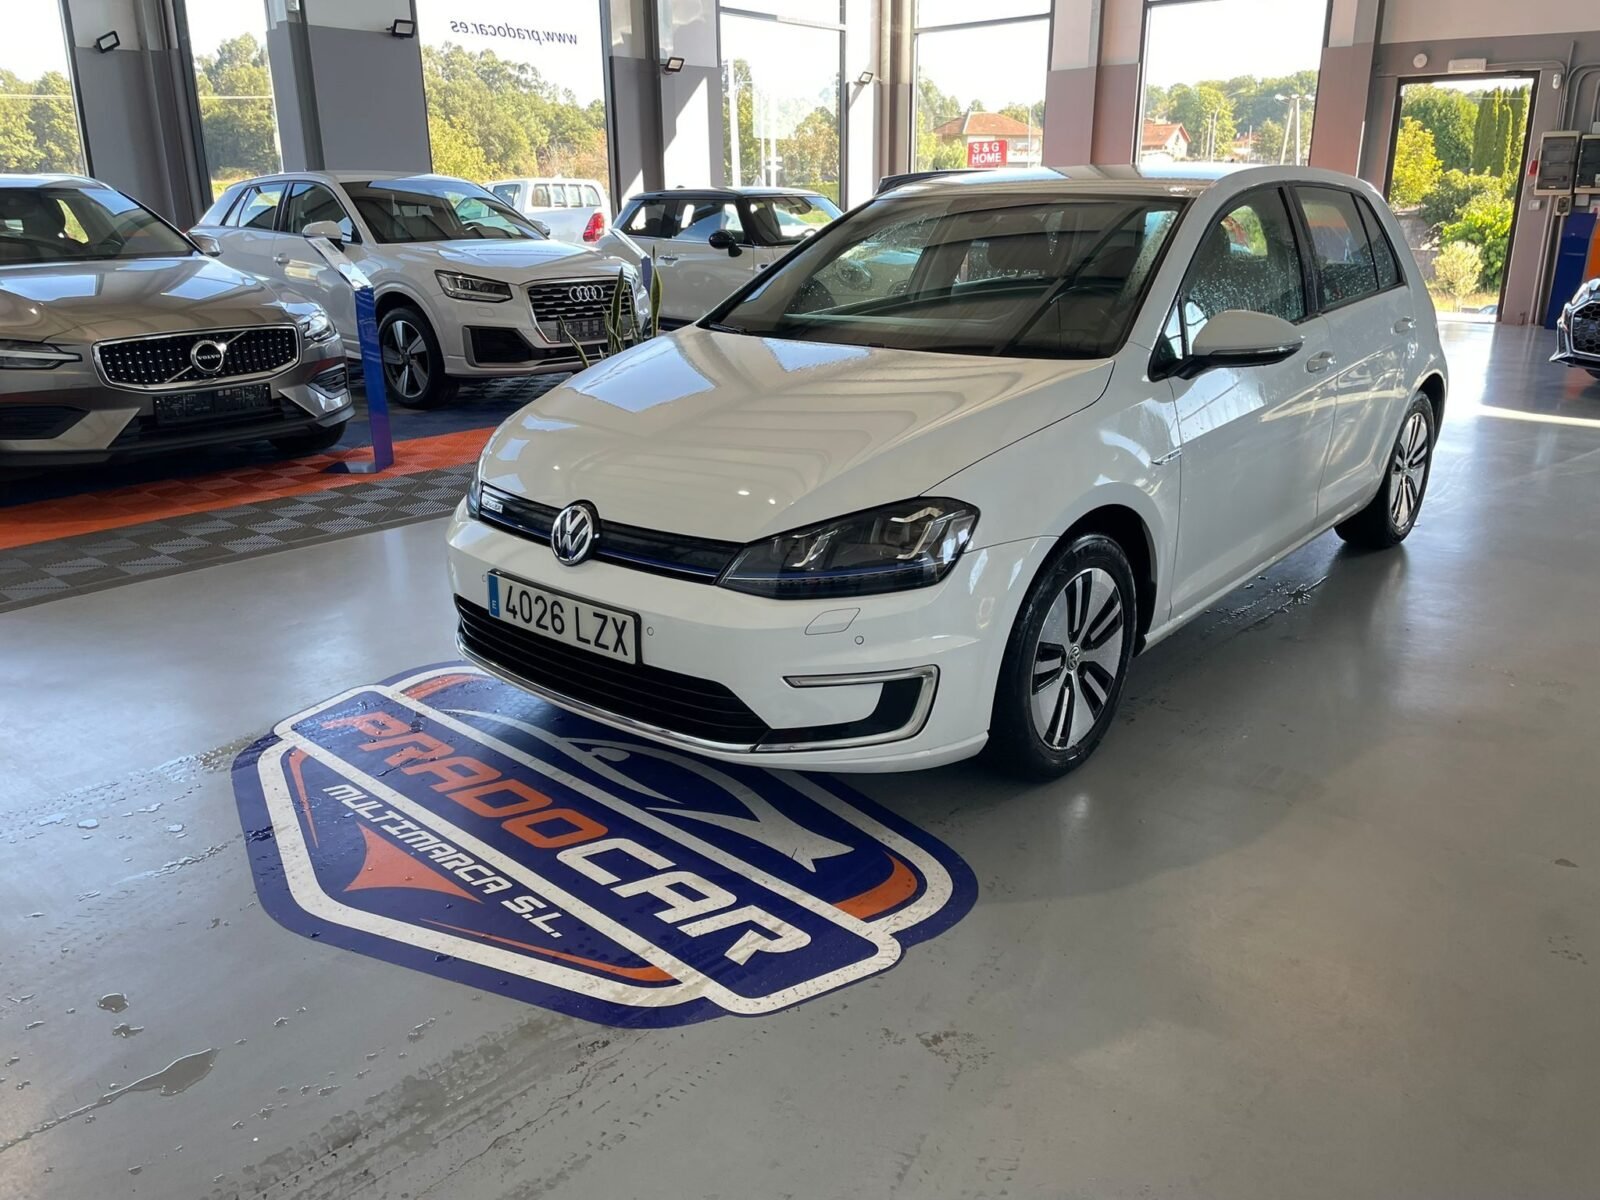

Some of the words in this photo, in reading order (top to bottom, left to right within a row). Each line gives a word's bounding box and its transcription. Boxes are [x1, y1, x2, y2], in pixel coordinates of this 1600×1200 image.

[971, 153, 1002, 164] HOME
[973, 143, 980, 153] S
[982, 142, 990, 152] &
[991, 142, 1000, 152] G
[505, 585, 565, 635] 4026
[575, 606, 628, 657] LZX
[320, 711, 812, 966] PRADOCAR
[322, 784, 513, 895] MULTIMARCA
[500, 895, 563, 938] S.L.
